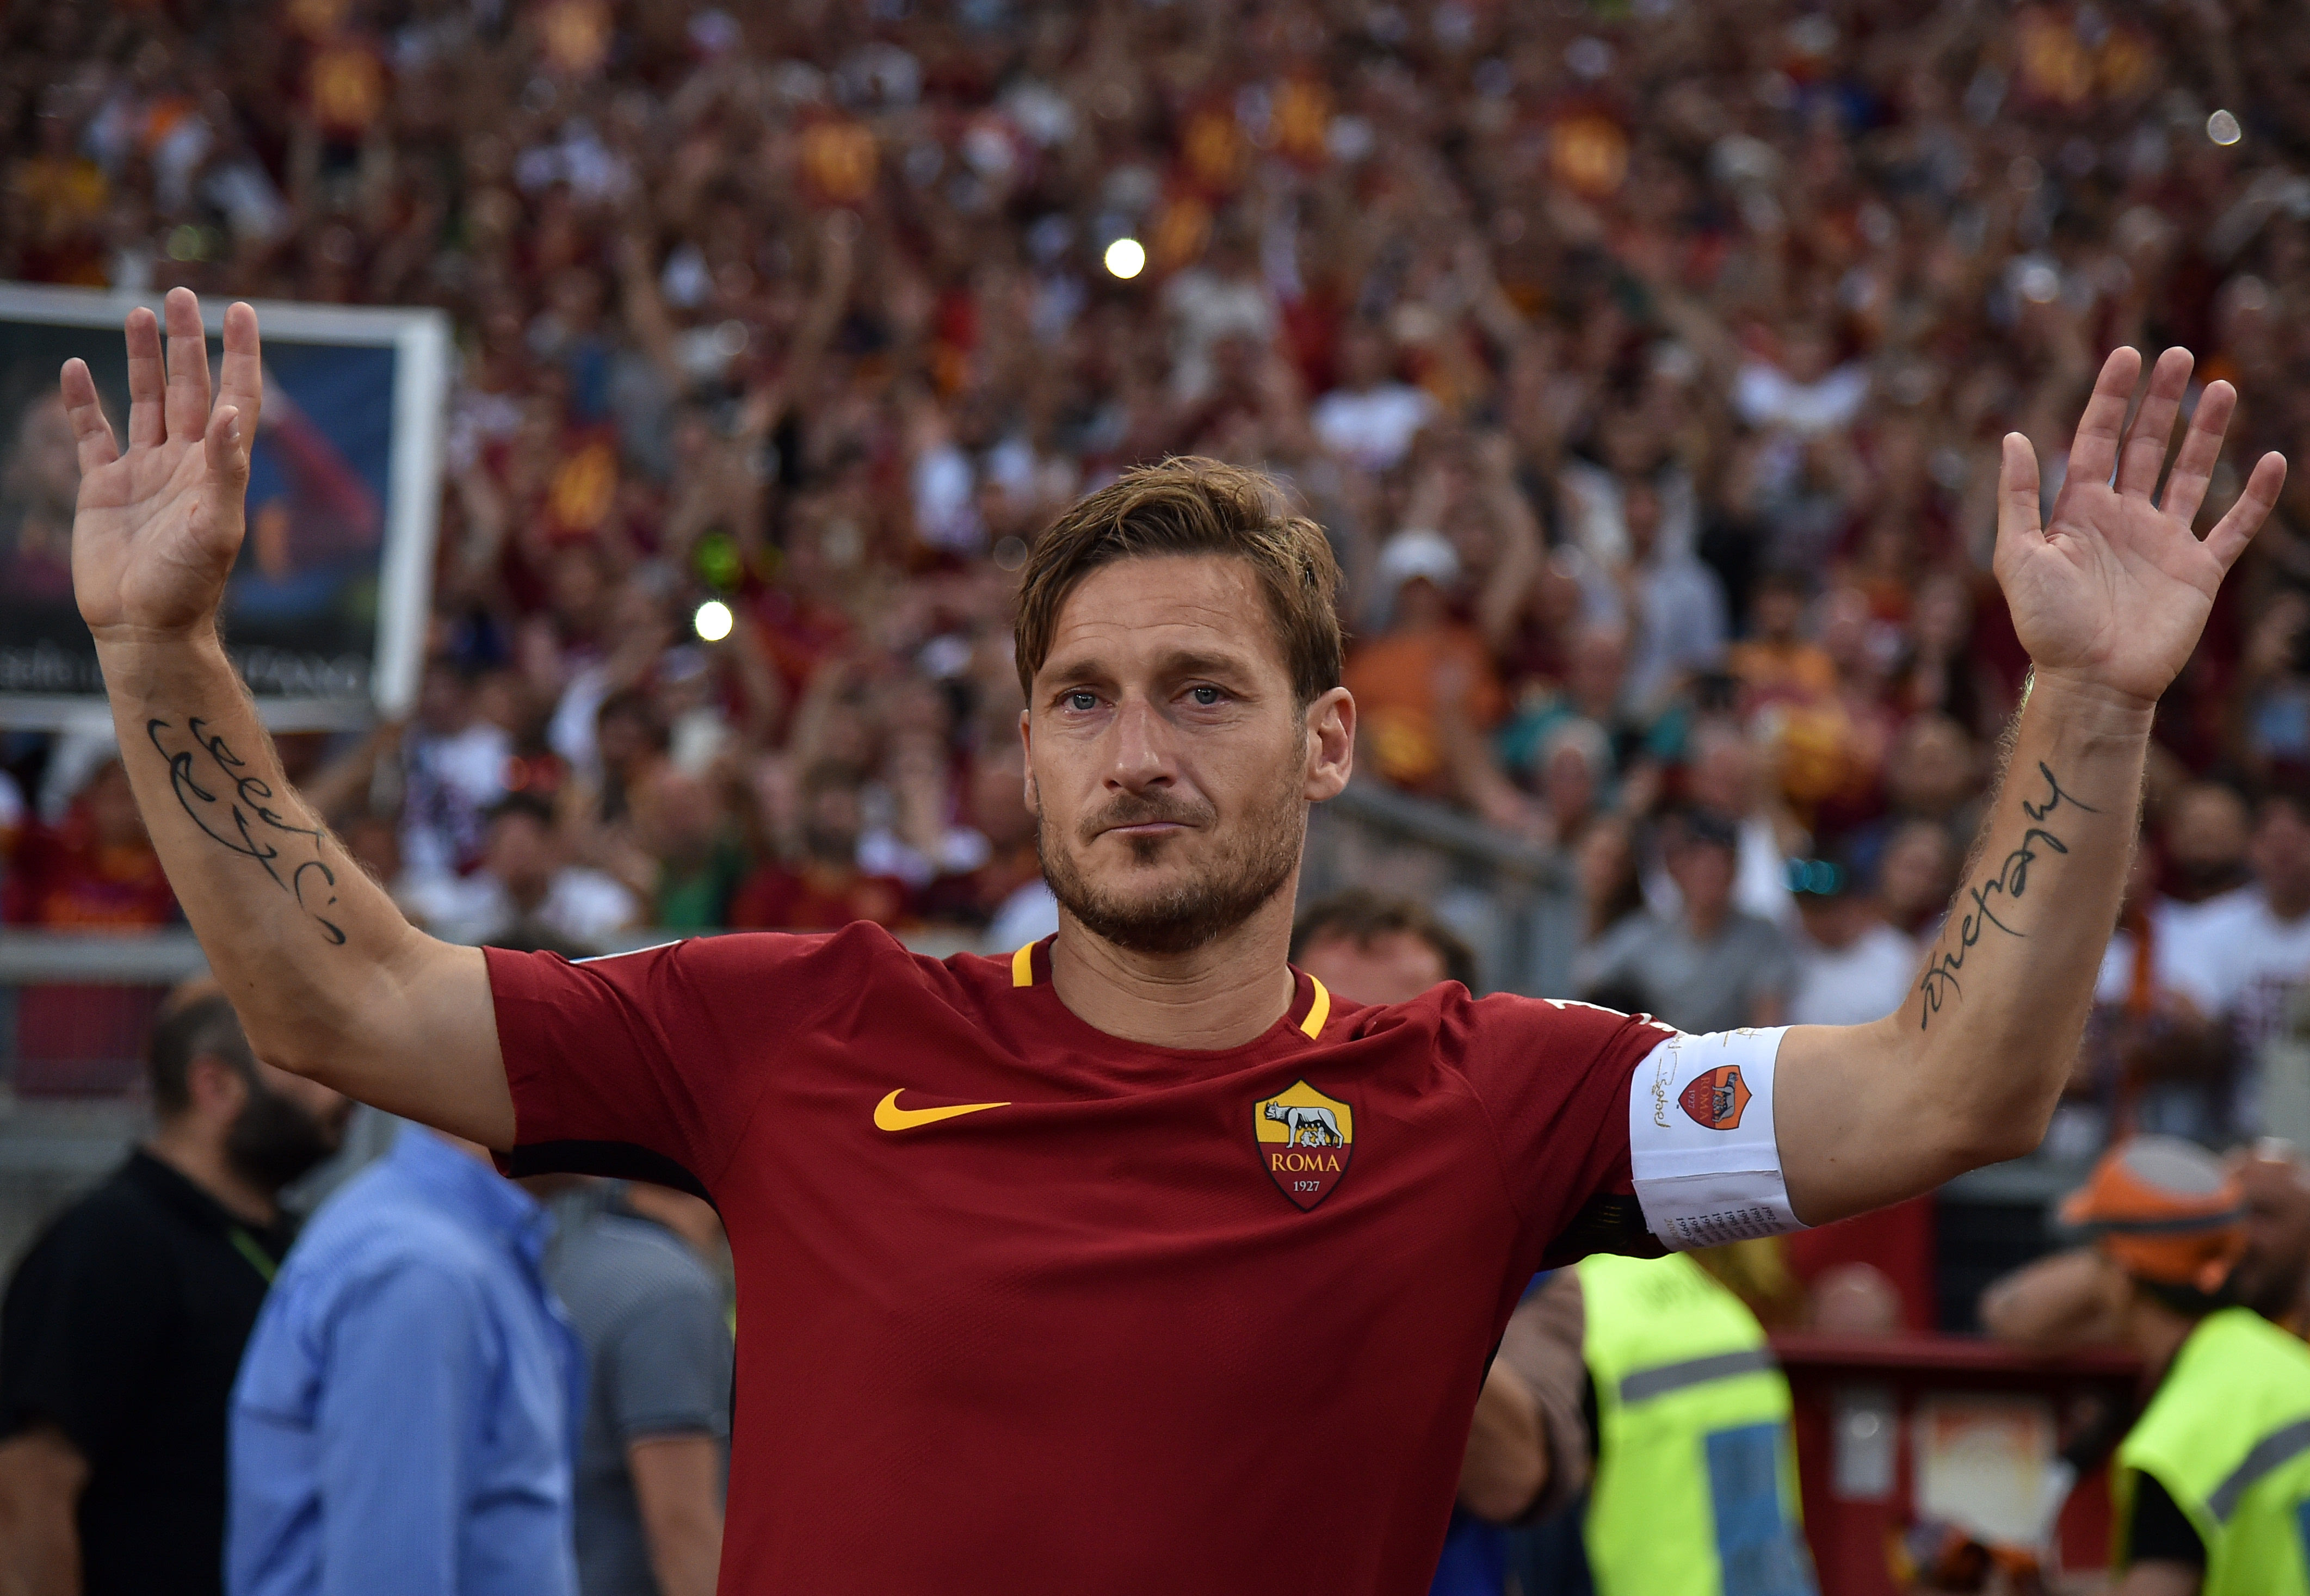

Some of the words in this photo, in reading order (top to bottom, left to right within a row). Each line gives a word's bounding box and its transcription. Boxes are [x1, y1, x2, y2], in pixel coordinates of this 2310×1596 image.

[1700, 1077, 1710, 1120] ROMA
[1271, 1153, 1341, 1172] ROMA
[1293, 1181, 1320, 1191] 1927
